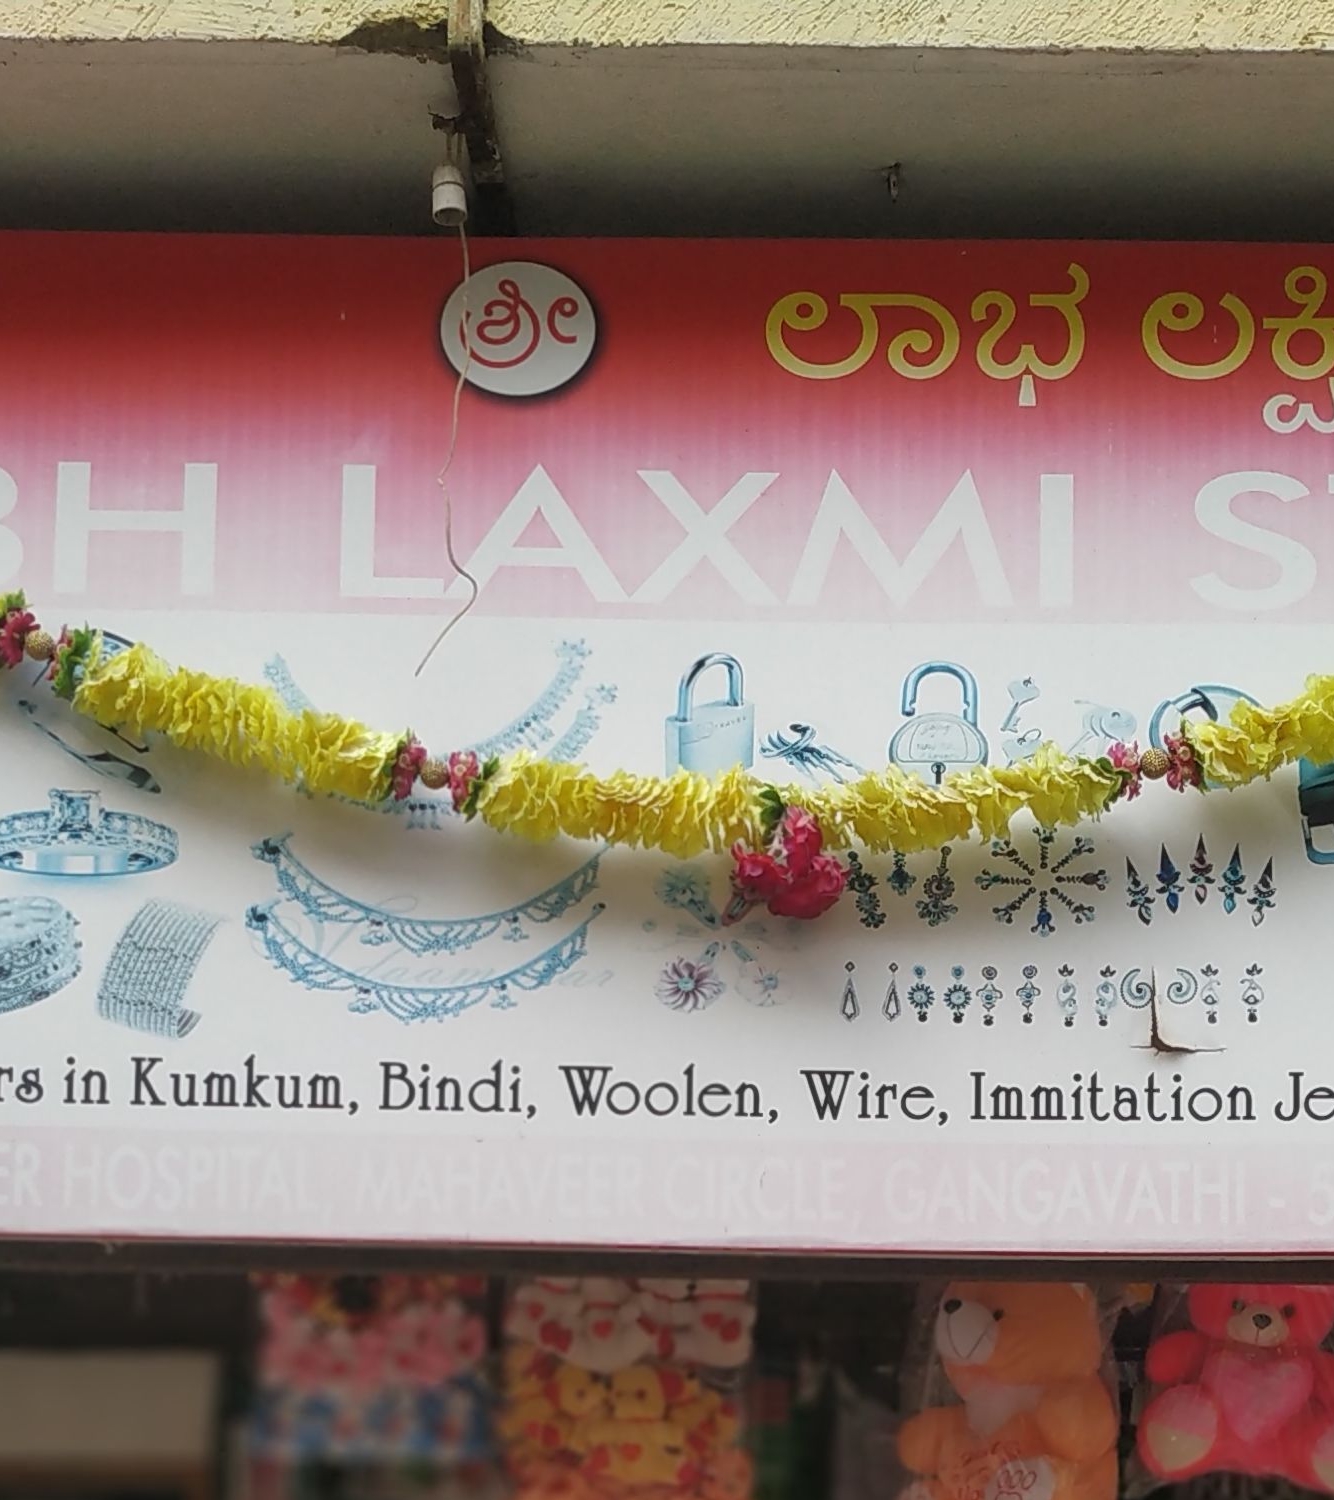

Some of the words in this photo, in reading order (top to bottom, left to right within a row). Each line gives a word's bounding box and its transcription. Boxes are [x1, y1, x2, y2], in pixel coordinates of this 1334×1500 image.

[765, 263, 1091, 407] ಲಾಭ
[339, 463, 1073, 604] LAXMI
[62, 1055, 110, 1106] in
[128, 1053, 361, 1115] Kumkum,
[378, 1058, 539, 1120] Bindi,
[559, 1062, 781, 1124] Woolen,
[800, 1069, 949, 1126] Wire,
[970, 1069, 1257, 1123] Immitation
[880, 1156, 1248, 1227] GANGAVATHI
